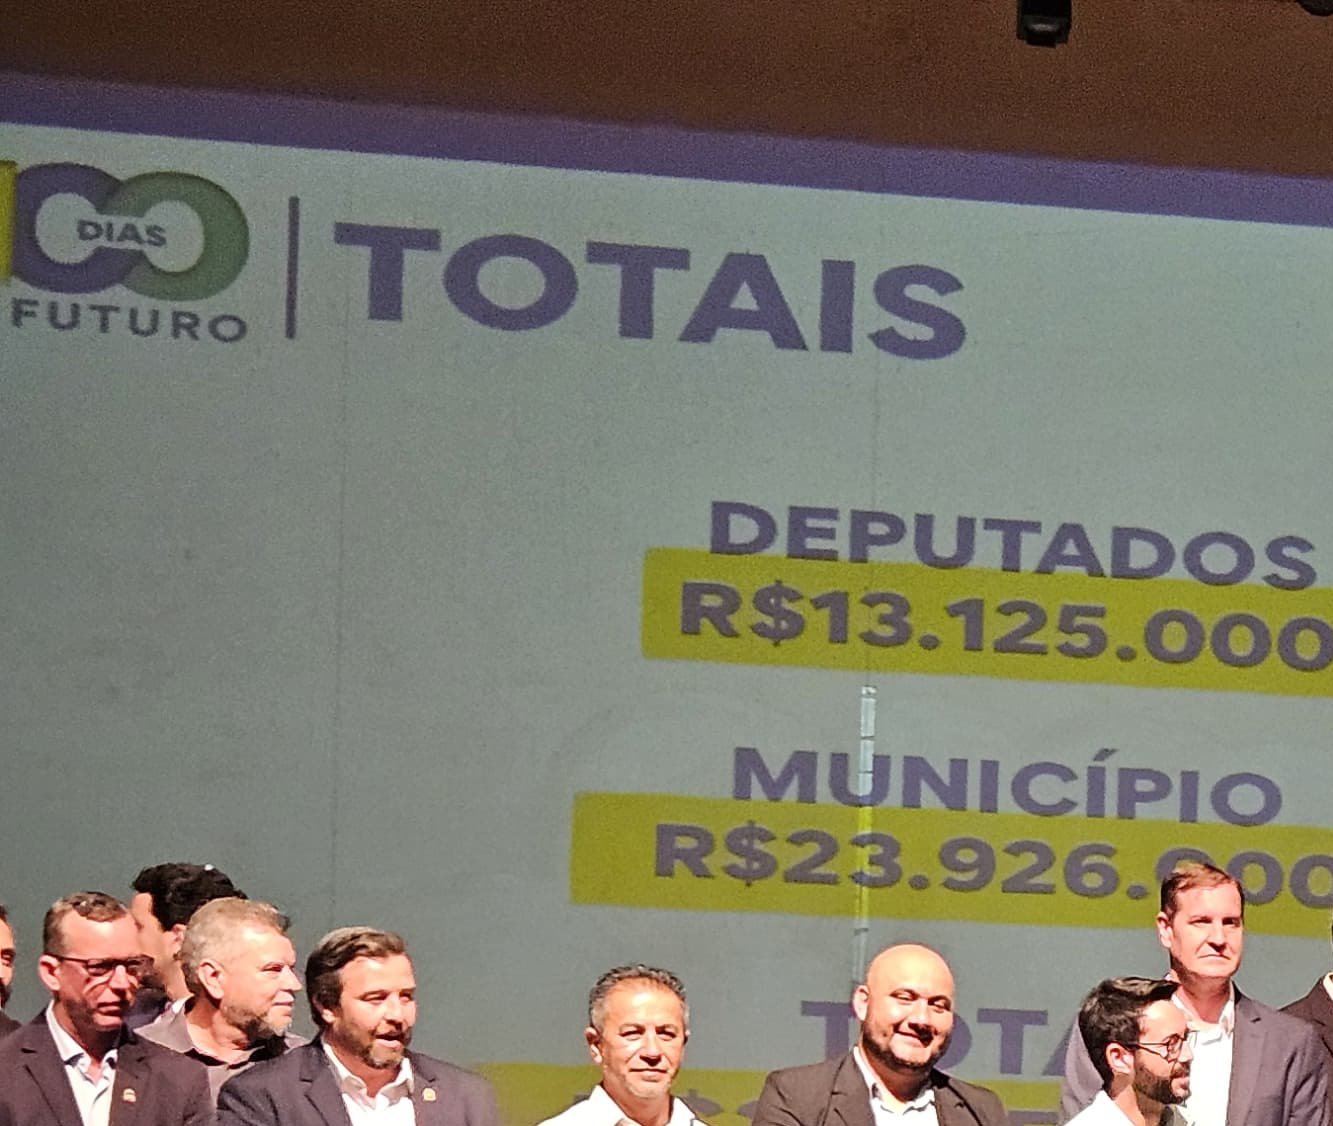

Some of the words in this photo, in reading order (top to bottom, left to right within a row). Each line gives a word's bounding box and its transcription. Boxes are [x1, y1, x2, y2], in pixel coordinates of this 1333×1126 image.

[0, 160, 249, 301] 00
[77, 220, 167, 247] DIAS
[11, 297, 247, 343] FUTURO
[333, 222, 968, 360] TOTAIS
[709, 501, 1318, 591] DEPUTADOS
[732, 747, 1283, 827] MUNICÍPIO
